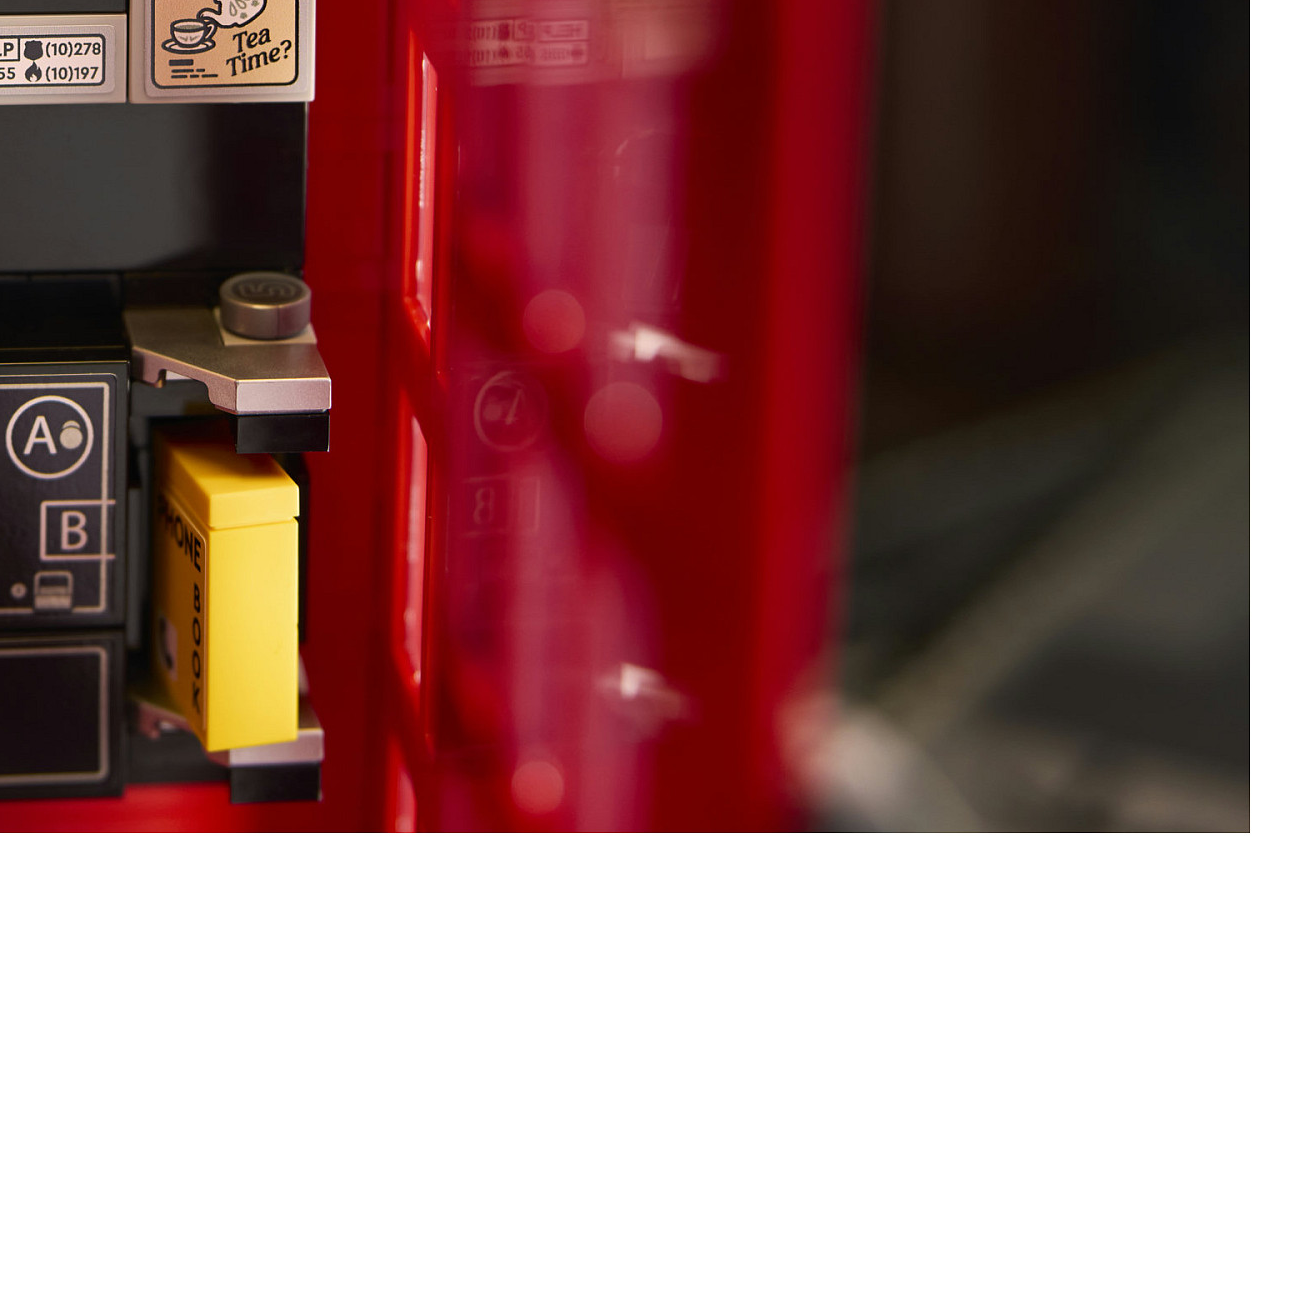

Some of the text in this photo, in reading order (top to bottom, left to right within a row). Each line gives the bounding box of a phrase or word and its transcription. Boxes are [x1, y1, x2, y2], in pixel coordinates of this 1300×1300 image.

[45, 42, 101, 58] (10)278
[226, 39, 293, 77] Time?
[232, 28, 272, 54] Tea
[45, 66, 100, 82] (10)197
[23, 415, 58, 456] A
[60, 510, 89, 552] B
[156, 494, 202, 573] PHONE
[191, 581, 201, 714] BOOK
